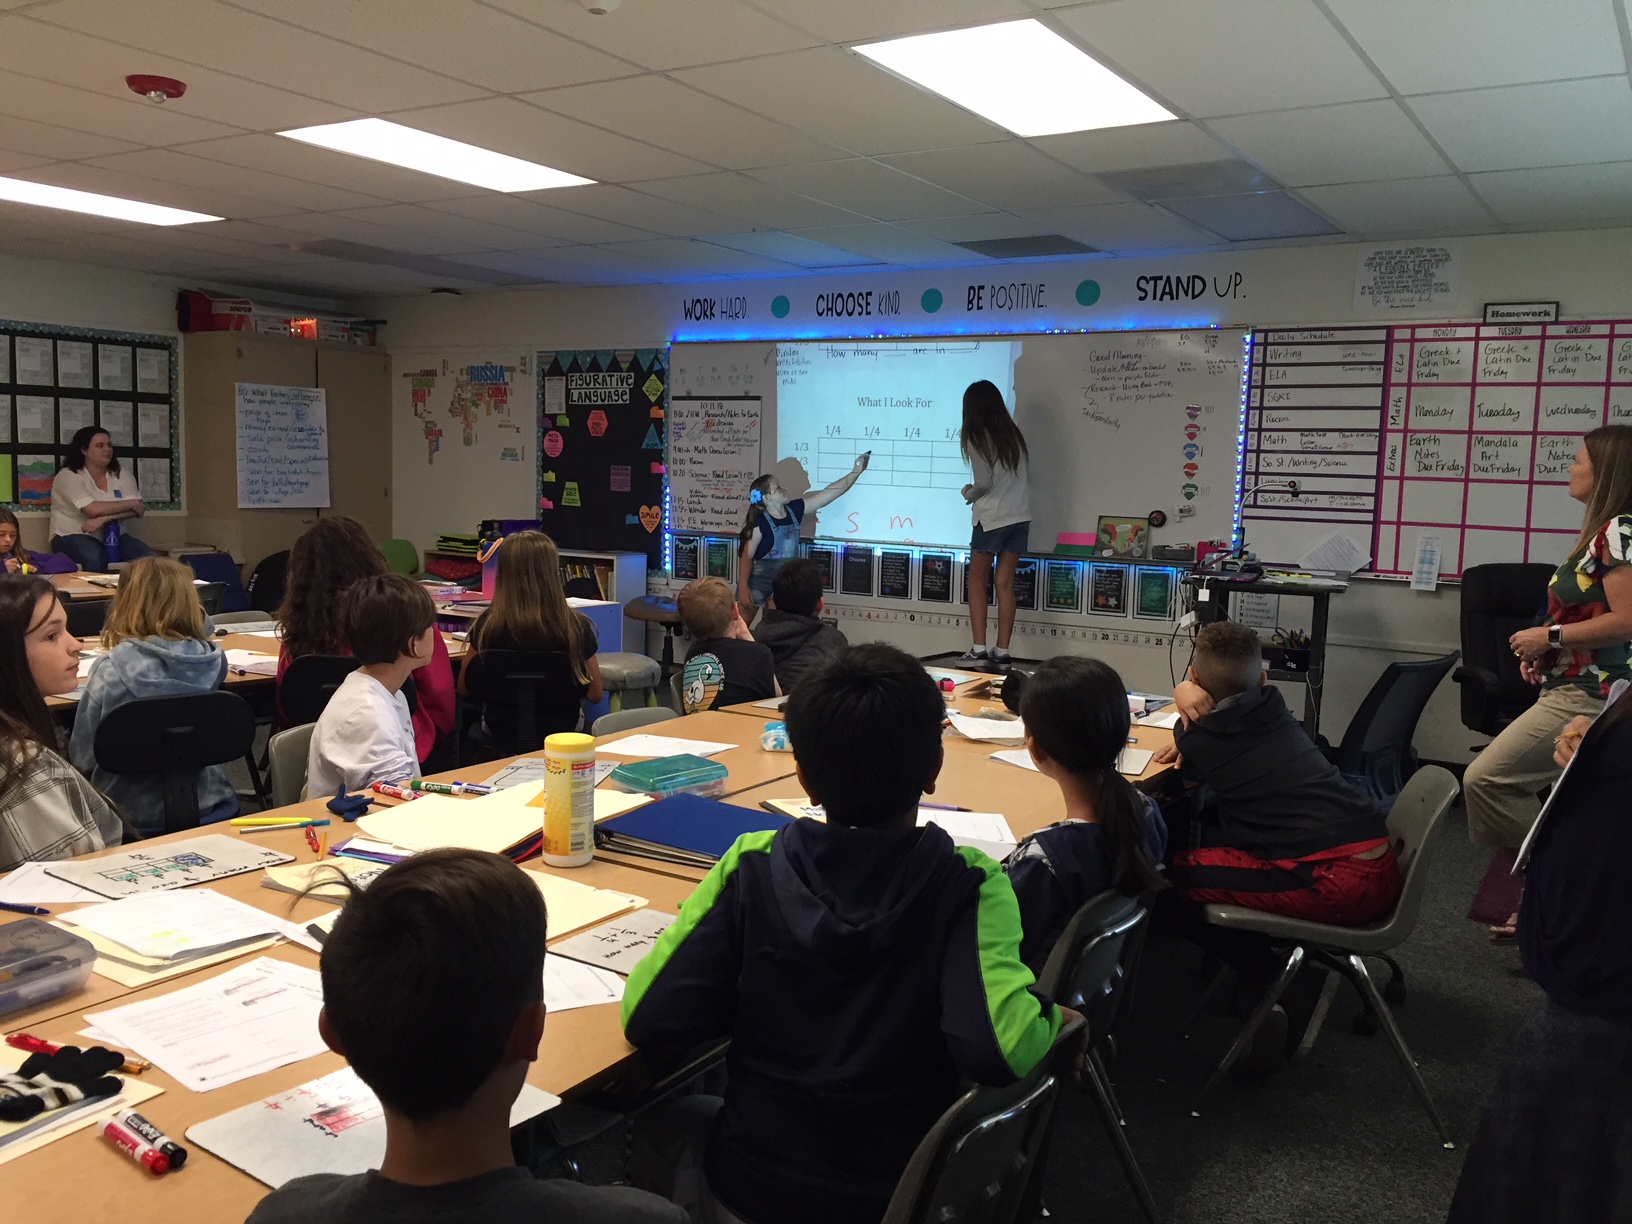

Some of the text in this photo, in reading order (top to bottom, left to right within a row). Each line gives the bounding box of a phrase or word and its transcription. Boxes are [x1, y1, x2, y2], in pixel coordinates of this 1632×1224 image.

[1136, 273, 1246, 302] STAND UP.
[967, 285, 985, 311] BE
[683, 298, 750, 321] WORK HARD.
[816, 292, 872, 318] CHOOSE
[1491, 309, 1551, 318] Homework
[1272, 332, 1295, 342] Daily
[1433, 328, 1457, 336] MONDAY
[1498, 327, 1522, 336] TUESDAY
[1419, 345, 1451, 359] Greek
[1484, 342, 1515, 355] Greek
[1554, 341, 1583, 354] Greek
[826, 347, 846, 358] How
[854, 349, 878, 361] many
[936, 347, 946, 355] in
[1089, 351, 1111, 363] Good
[1270, 349, 1302, 361] Writing
[1485, 354, 1532, 365] Latin Due
[1553, 354, 1602, 364] Latin Due
[1394, 353, 1405, 373] ELA
[1416, 357, 1461, 368] Latin Due
[470, 365, 505, 382] RUSSIA
[1270, 371, 1287, 380] ELA
[1416, 368, 1440, 380] Friday
[1482, 366, 1508, 378] Friday
[1547, 365, 1577, 376] Friday
[252, 388, 267, 397] What
[488, 387, 508, 398] CHINA
[857, 397, 932, 408] What I Look For
[1391, 397, 1403, 426] Math
[1415, 405, 1454, 421] Monday
[1477, 403, 1520, 421] Tuesday
[1546, 404, 1597, 419] Wednesday
[825, 424, 841, 436] 1/4
[864, 426, 881, 437] 1/4
[904, 427, 921, 438] 1/4
[1262, 434, 1287, 445] Math
[1409, 433, 1441, 447] Earth
[1474, 436, 1518, 448] Mandala
[1540, 437, 1574, 447] Earth
[794, 441, 809, 451] 1/3
[1386, 445, 1397, 471] Extras
[1414, 450, 1439, 461] Notes
[1481, 451, 1500, 461] Art
[1547, 451, 1576, 461] Notes
[1417, 461, 1465, 476] Due Friday
[1472, 461, 1521, 477] Due Friday
[1537, 463, 1558, 474] Due
[1050, 627, 1057, 636] 15
[1071, 630, 1077, 638] 17
[1092, 632, 1098, 640] 19
[1101, 632, 1110, 641] 20
[1112, 633, 1119, 641] 21
[1123, 634, 1130, 642] 22
[1132, 635, 1139, 643] 23
[1155, 637, 1163, 646] 25
[1178, 639, 1185, 647] 27
